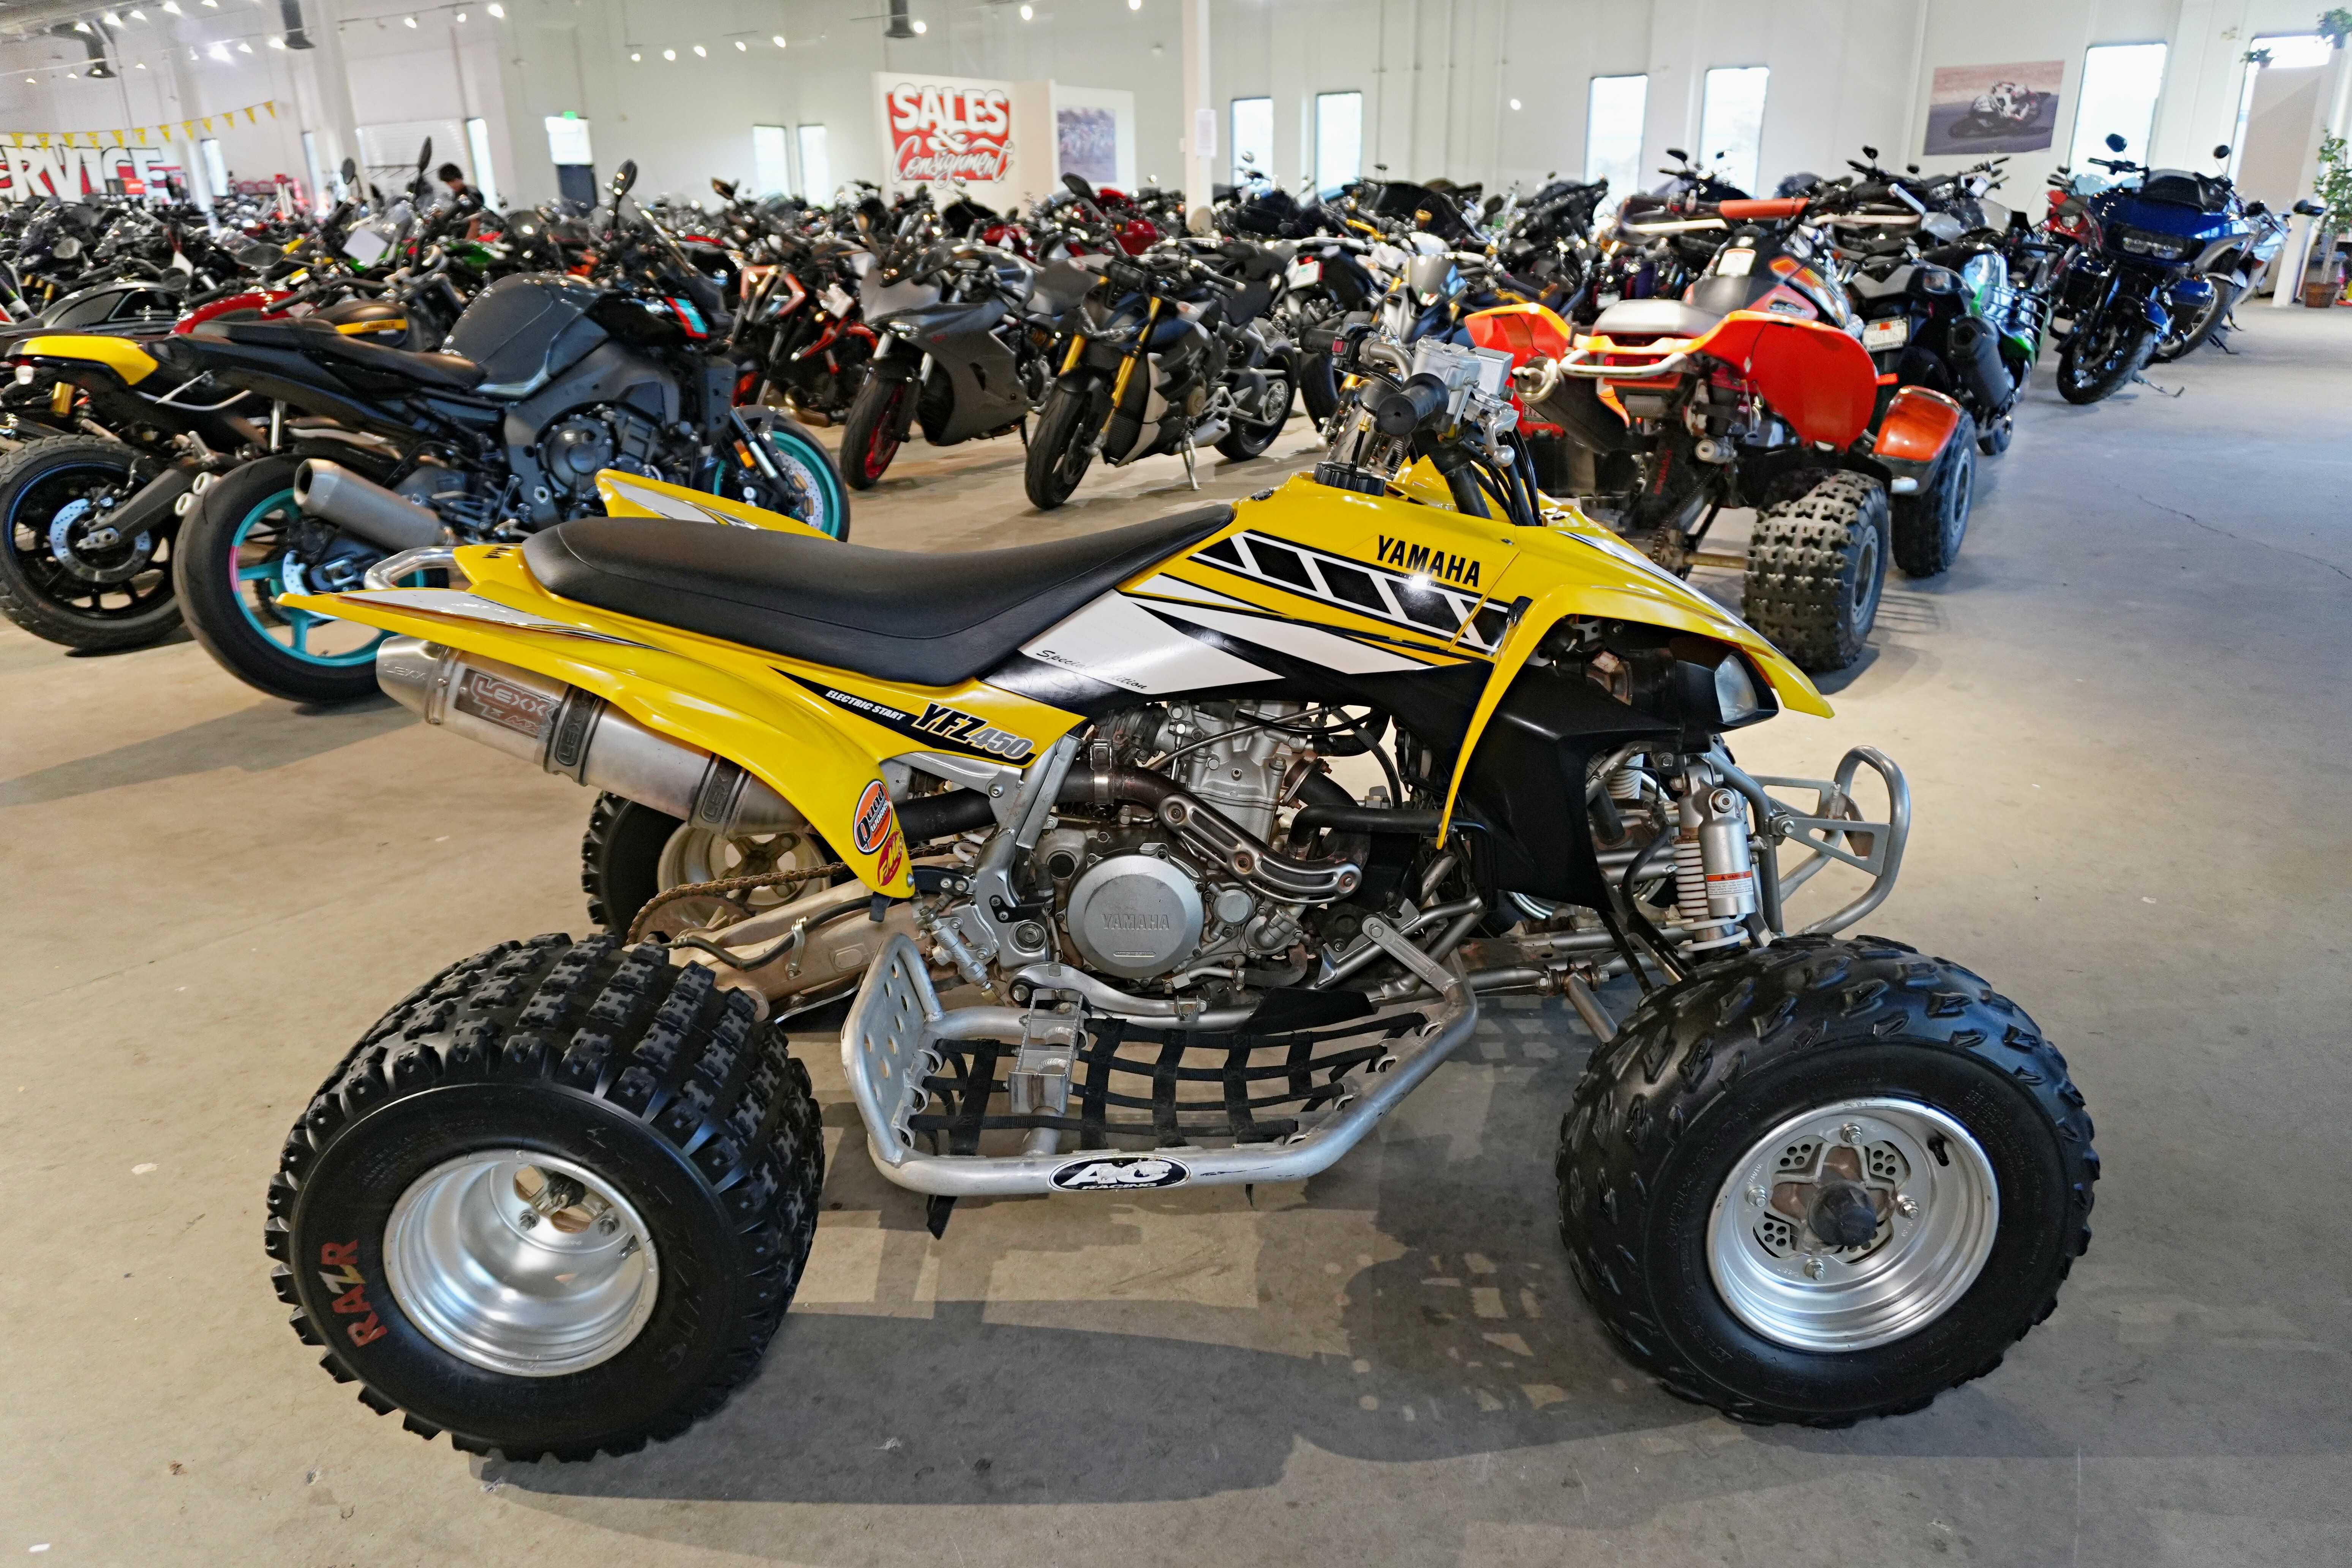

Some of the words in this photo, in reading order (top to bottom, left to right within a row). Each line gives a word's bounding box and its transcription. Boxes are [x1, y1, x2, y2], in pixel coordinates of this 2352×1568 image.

[893, 82, 1007, 137] SALES
[891, 135, 1015, 189] Consignment
[1377, 534, 1480, 587] YAMAHA
[1036, 650, 1094, 670] Special
[1103, 675, 1147, 689] dition
[477, 680, 548, 717] LEXX
[825, 690, 874, 710] ELECTRIC
[872, 705, 906, 721] START
[857, 783, 885, 851] Quad
[871, 800, 888, 832] WORKS
[1101, 913, 1170, 931] YAMAHA
[318, 1239, 388, 1348] RAZR
